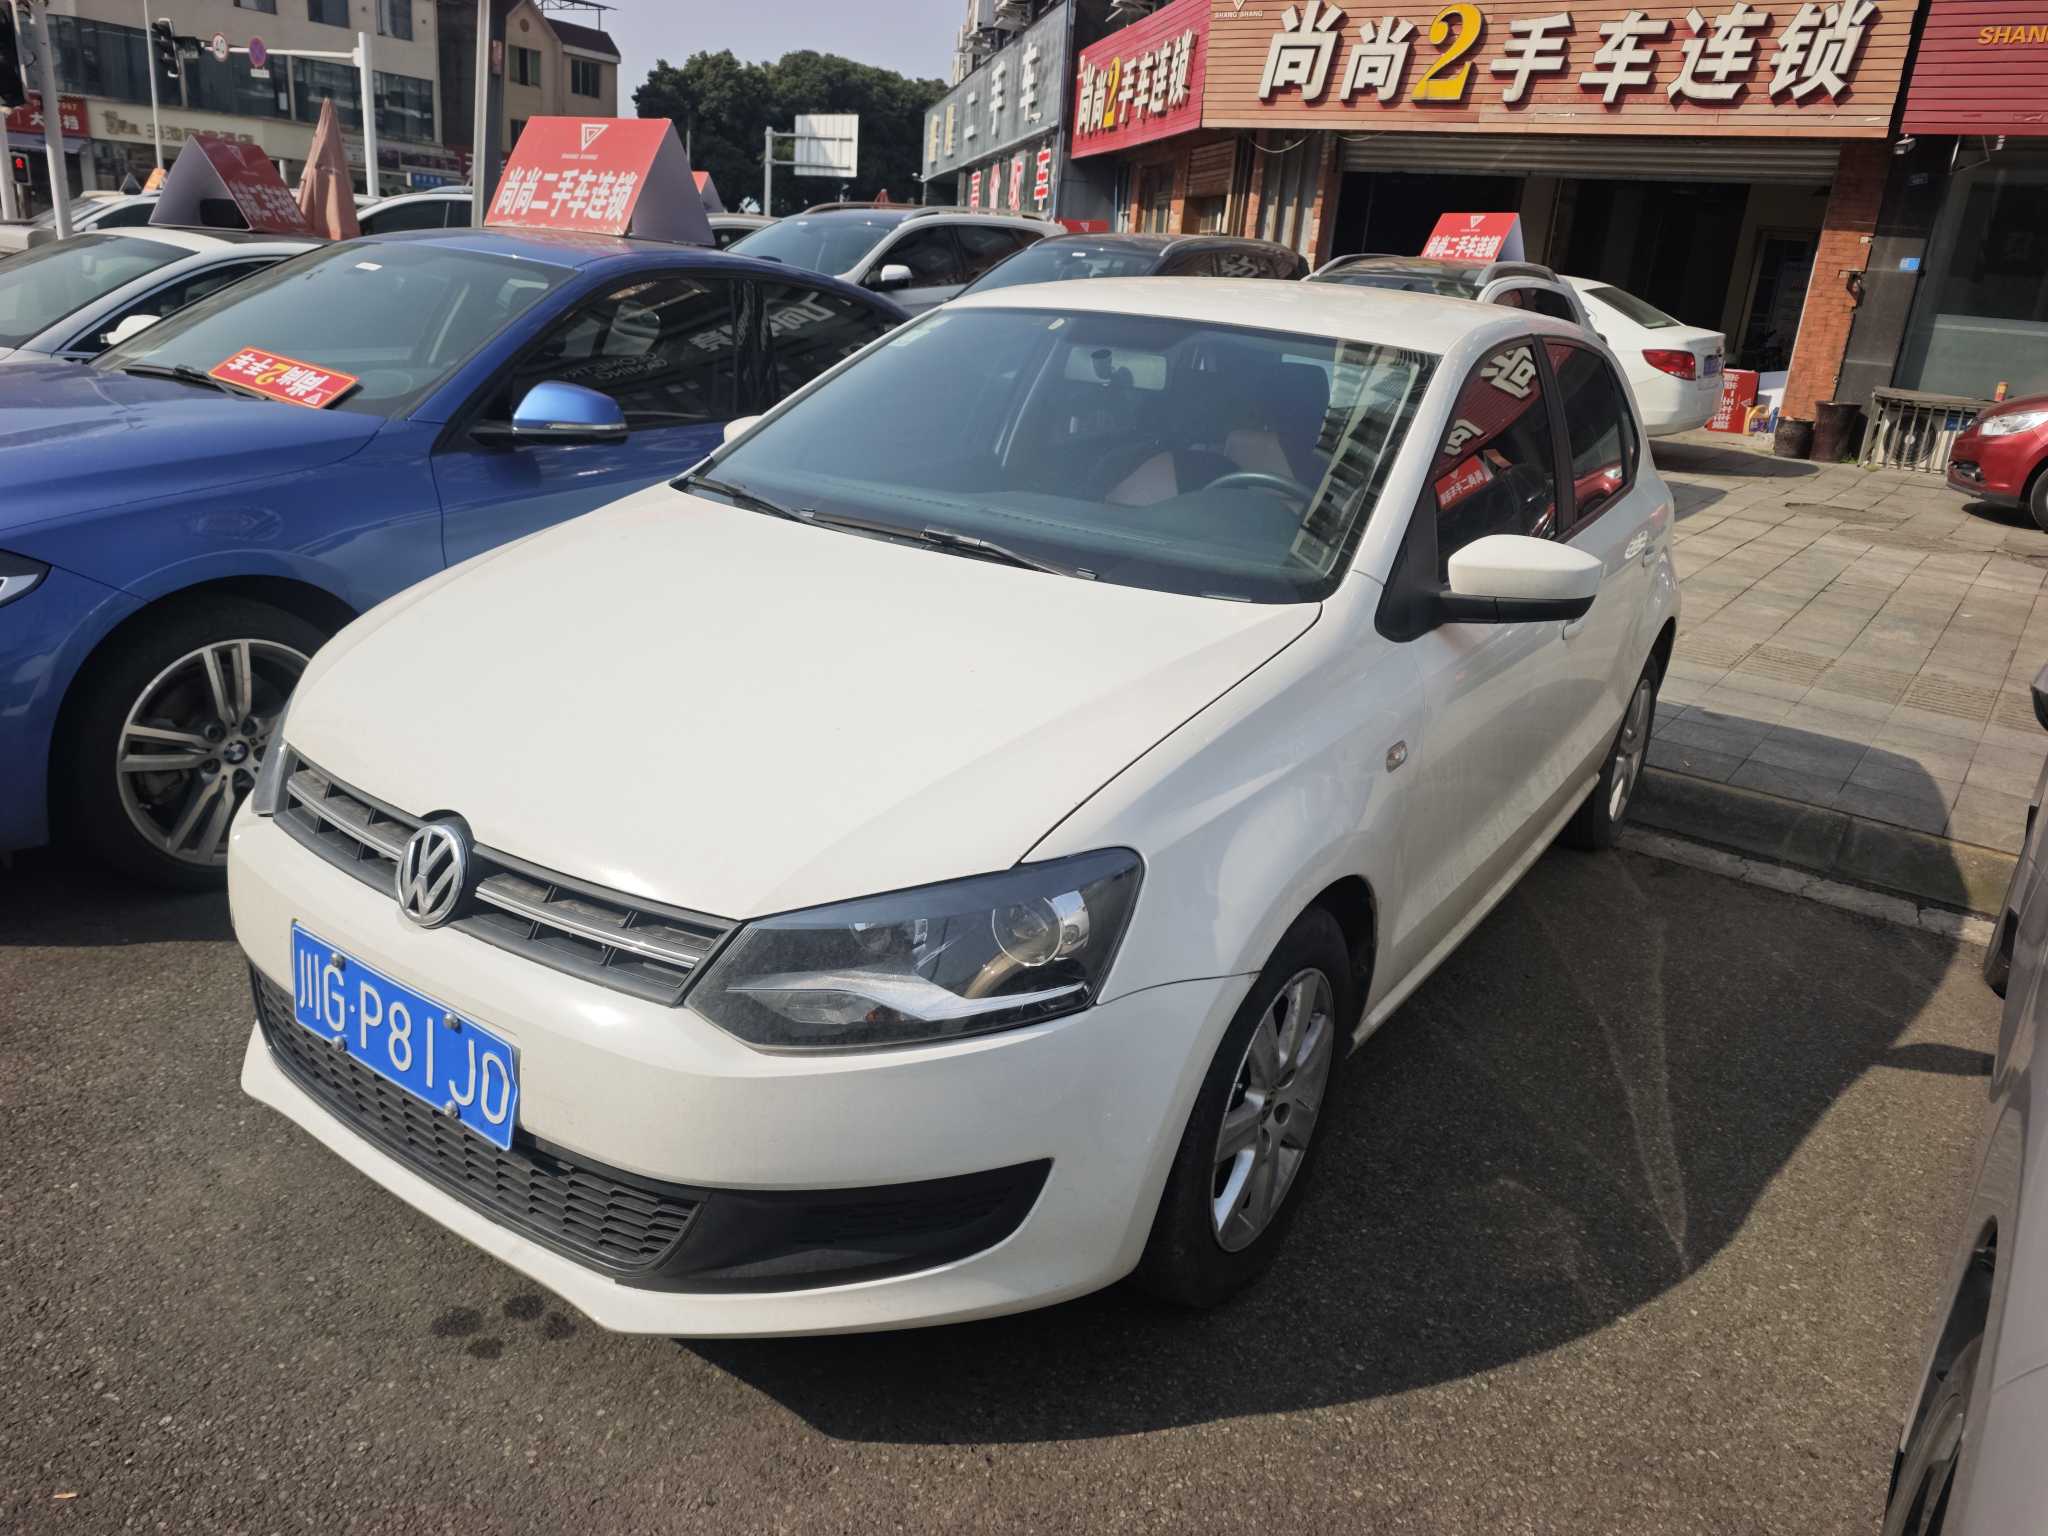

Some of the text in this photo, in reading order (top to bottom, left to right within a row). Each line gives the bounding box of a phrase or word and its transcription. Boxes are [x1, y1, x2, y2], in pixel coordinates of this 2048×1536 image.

[1258, 0, 1876, 104] 尚尚2手车连锁
[1978, 24, 2048, 45] SHAN
[1076, 30, 1194, 136] 尚尚2手车连锁
[494, 166, 638, 222] 尚尚二手车连锁
